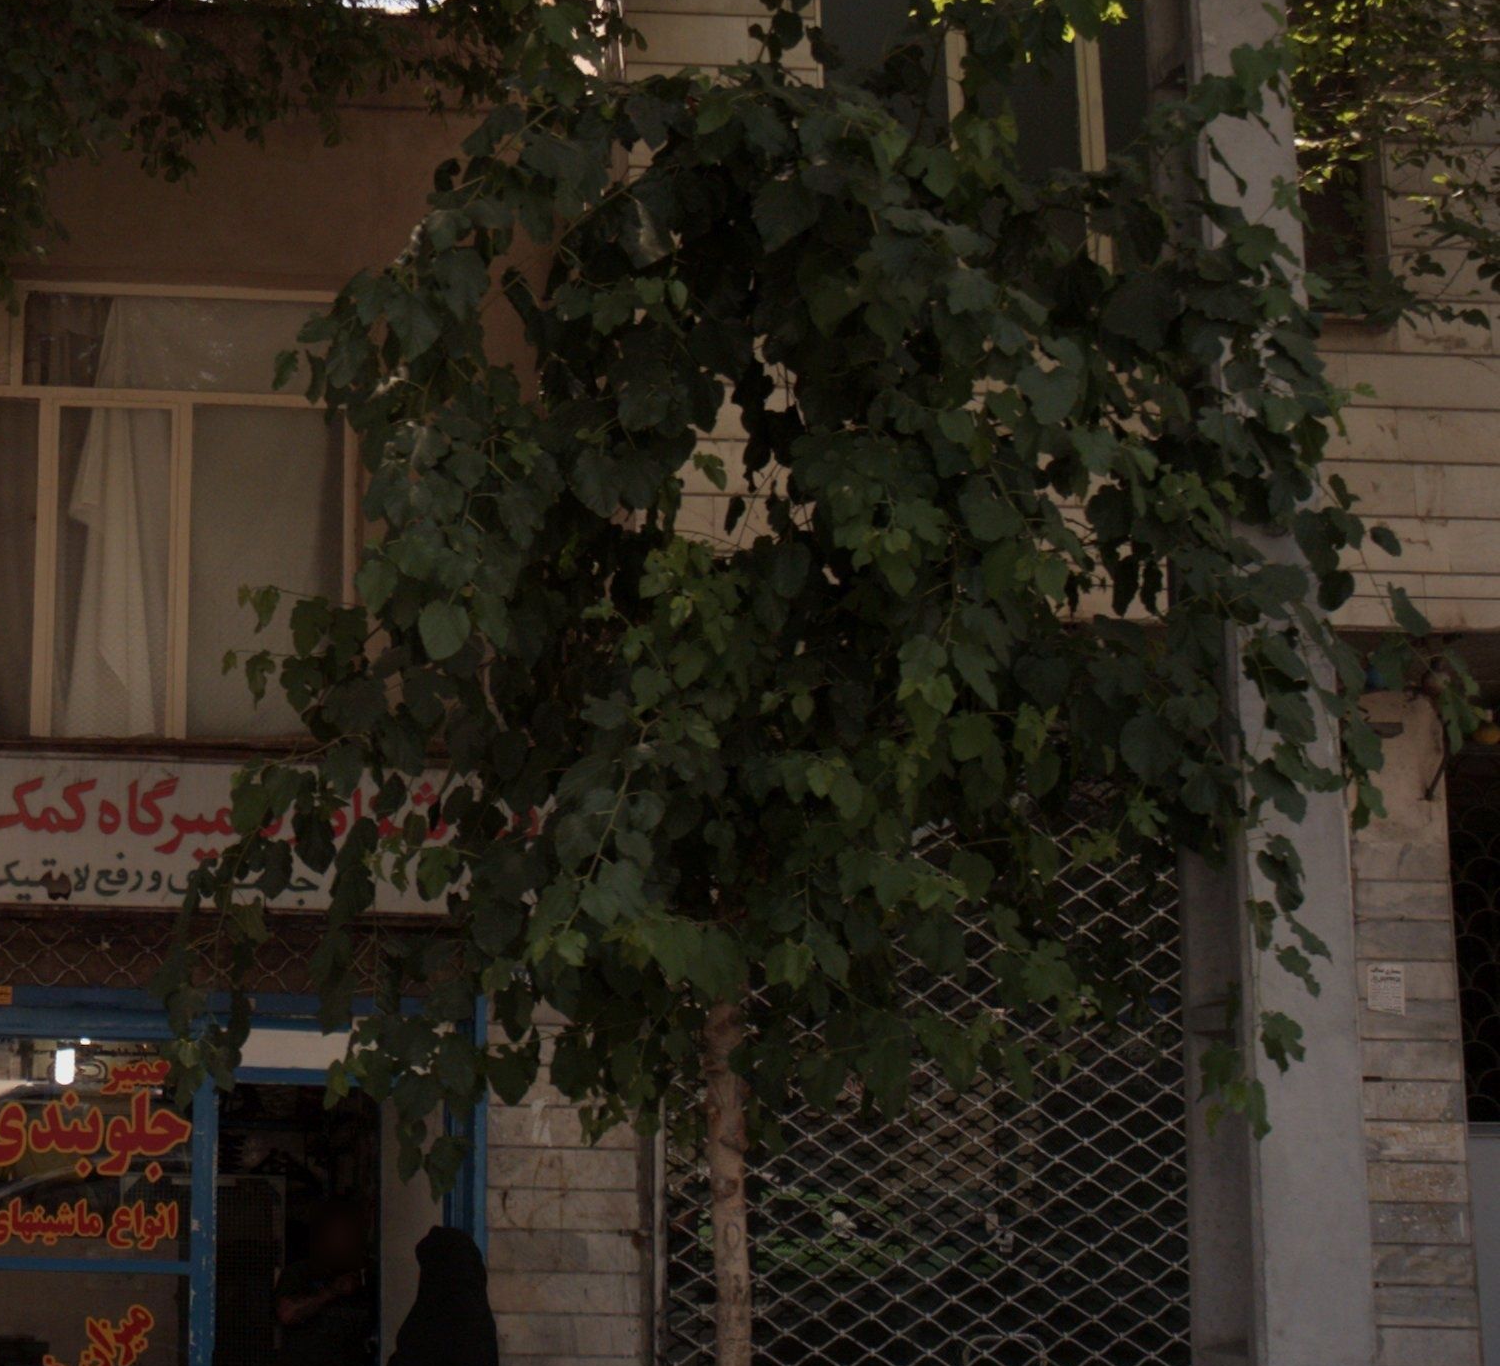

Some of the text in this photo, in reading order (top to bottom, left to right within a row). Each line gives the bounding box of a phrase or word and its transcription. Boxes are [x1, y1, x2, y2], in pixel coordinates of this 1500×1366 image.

[98, 777, 284, 861] میرگاه
[94, 851, 143, 896] رفع
[100, 1059, 172, 1095] عمیر
[106, 1199, 179, 1250] انواع
